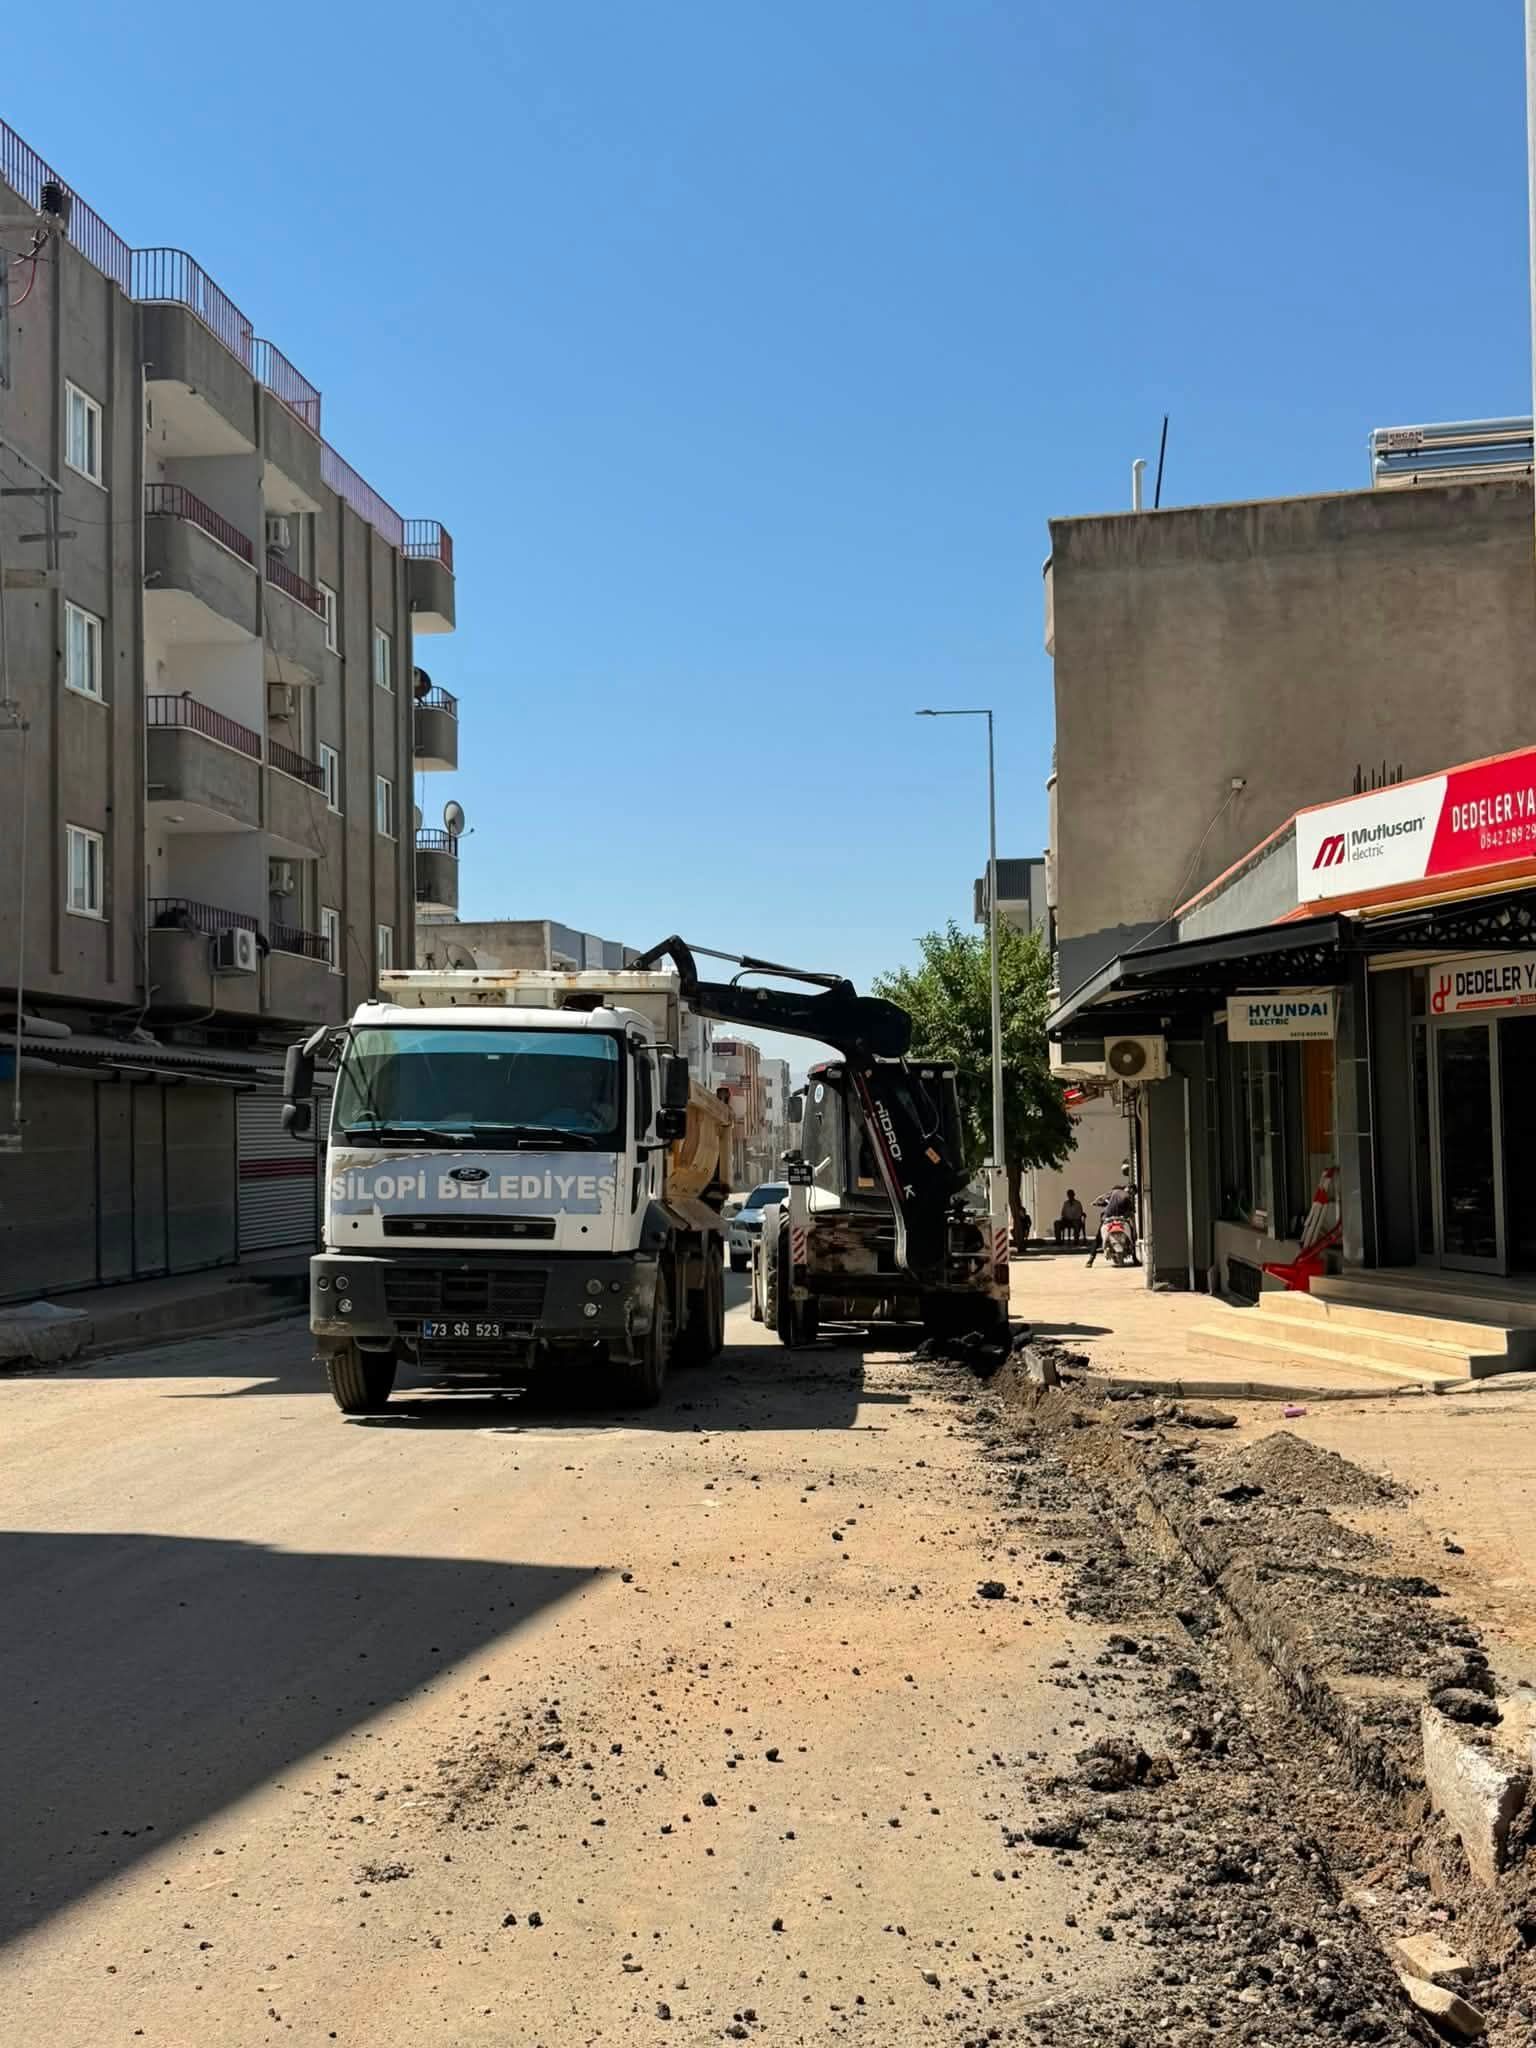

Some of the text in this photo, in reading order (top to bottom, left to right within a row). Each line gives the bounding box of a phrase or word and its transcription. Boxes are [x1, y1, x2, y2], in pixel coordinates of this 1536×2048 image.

[1452, 793, 1513, 833] DEDELER
[1351, 817, 1424, 846] Mutlusan
[1351, 842, 1385, 861] electric
[1456, 966, 1521, 996] DEDELER
[1249, 1003, 1328, 1017] HYUNDAI
[1249, 1018, 1289, 1026] ELECTRIC
[332, 1169, 426, 1200] SİLOPİ
[432, 1323, 447, 1336] 73
[454, 1322, 469, 1336] SG
[476, 1323, 500, 1336] 523
